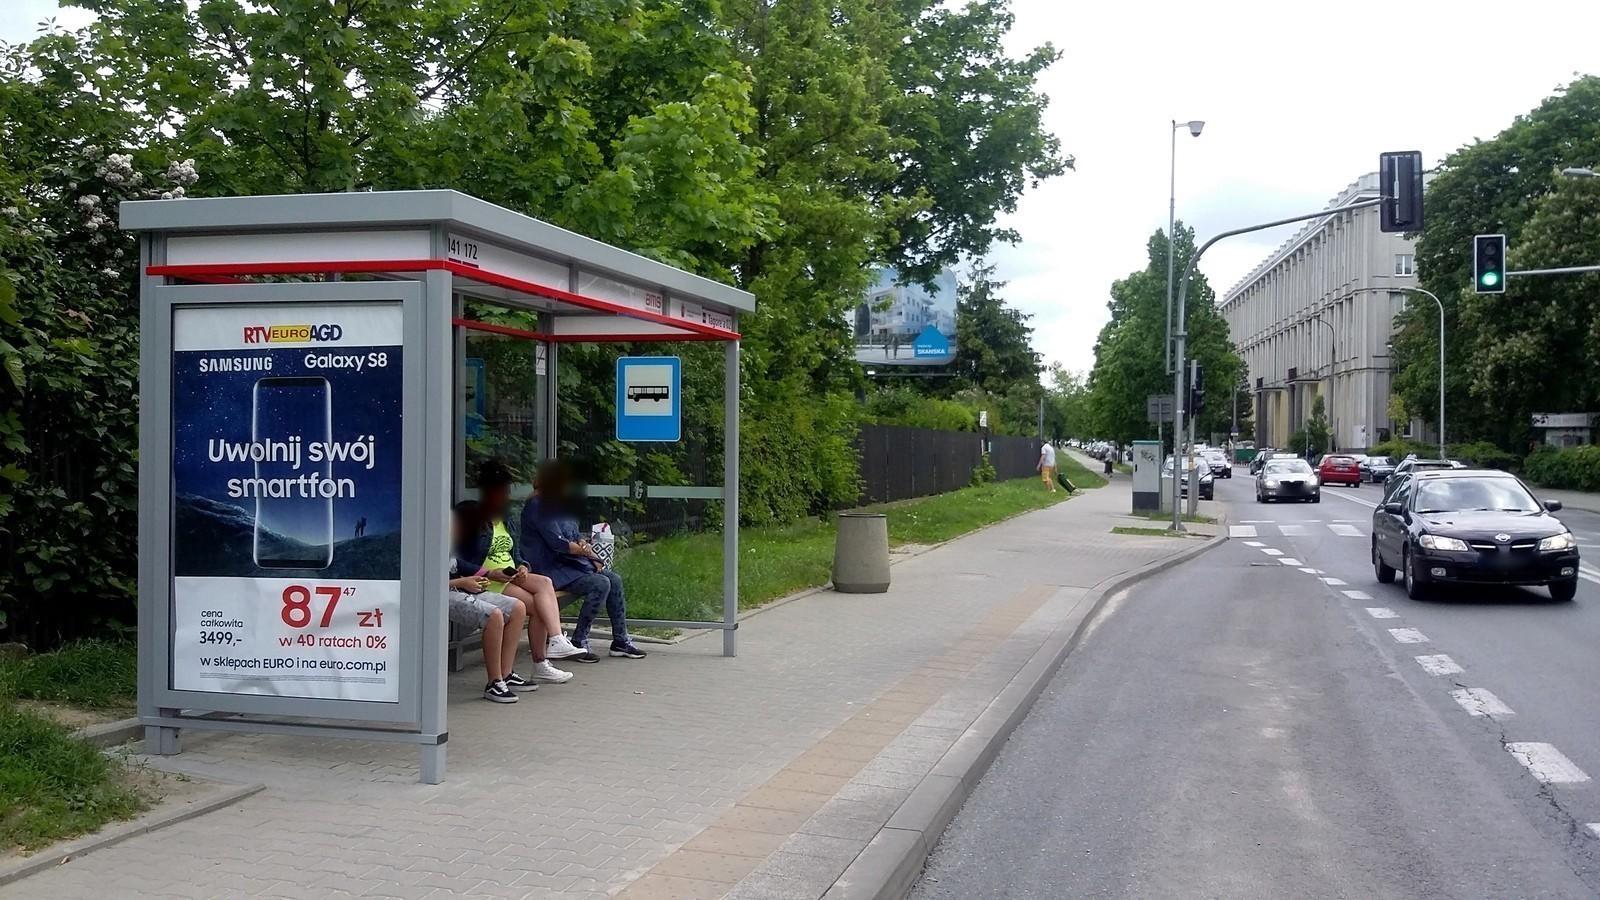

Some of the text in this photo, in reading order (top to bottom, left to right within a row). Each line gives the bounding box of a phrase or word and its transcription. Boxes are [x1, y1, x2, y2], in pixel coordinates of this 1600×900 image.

[448, 237, 478, 260] 141 172
[645, 293, 661, 309] ams
[199, 356, 273, 372] SAMSUNG
[304, 352, 388, 371] Galaxy S8
[208, 435, 375, 470] Uwolnij swój
[227, 472, 355, 498] smartfon
[201, 610, 223, 618] cena
[281, 585, 384, 629] 87 47 zł
[200, 618, 244, 628] całkowita
[199, 631, 242, 647] 3499,-
[279, 634, 387, 649] w 40 ratach 0%
[200, 657, 211, 666] w
[213, 656, 261, 671] sklepach
[263, 658, 294, 669] EURO
[302, 660, 317, 669] na
[320, 660, 386, 675] euro.com.pl
